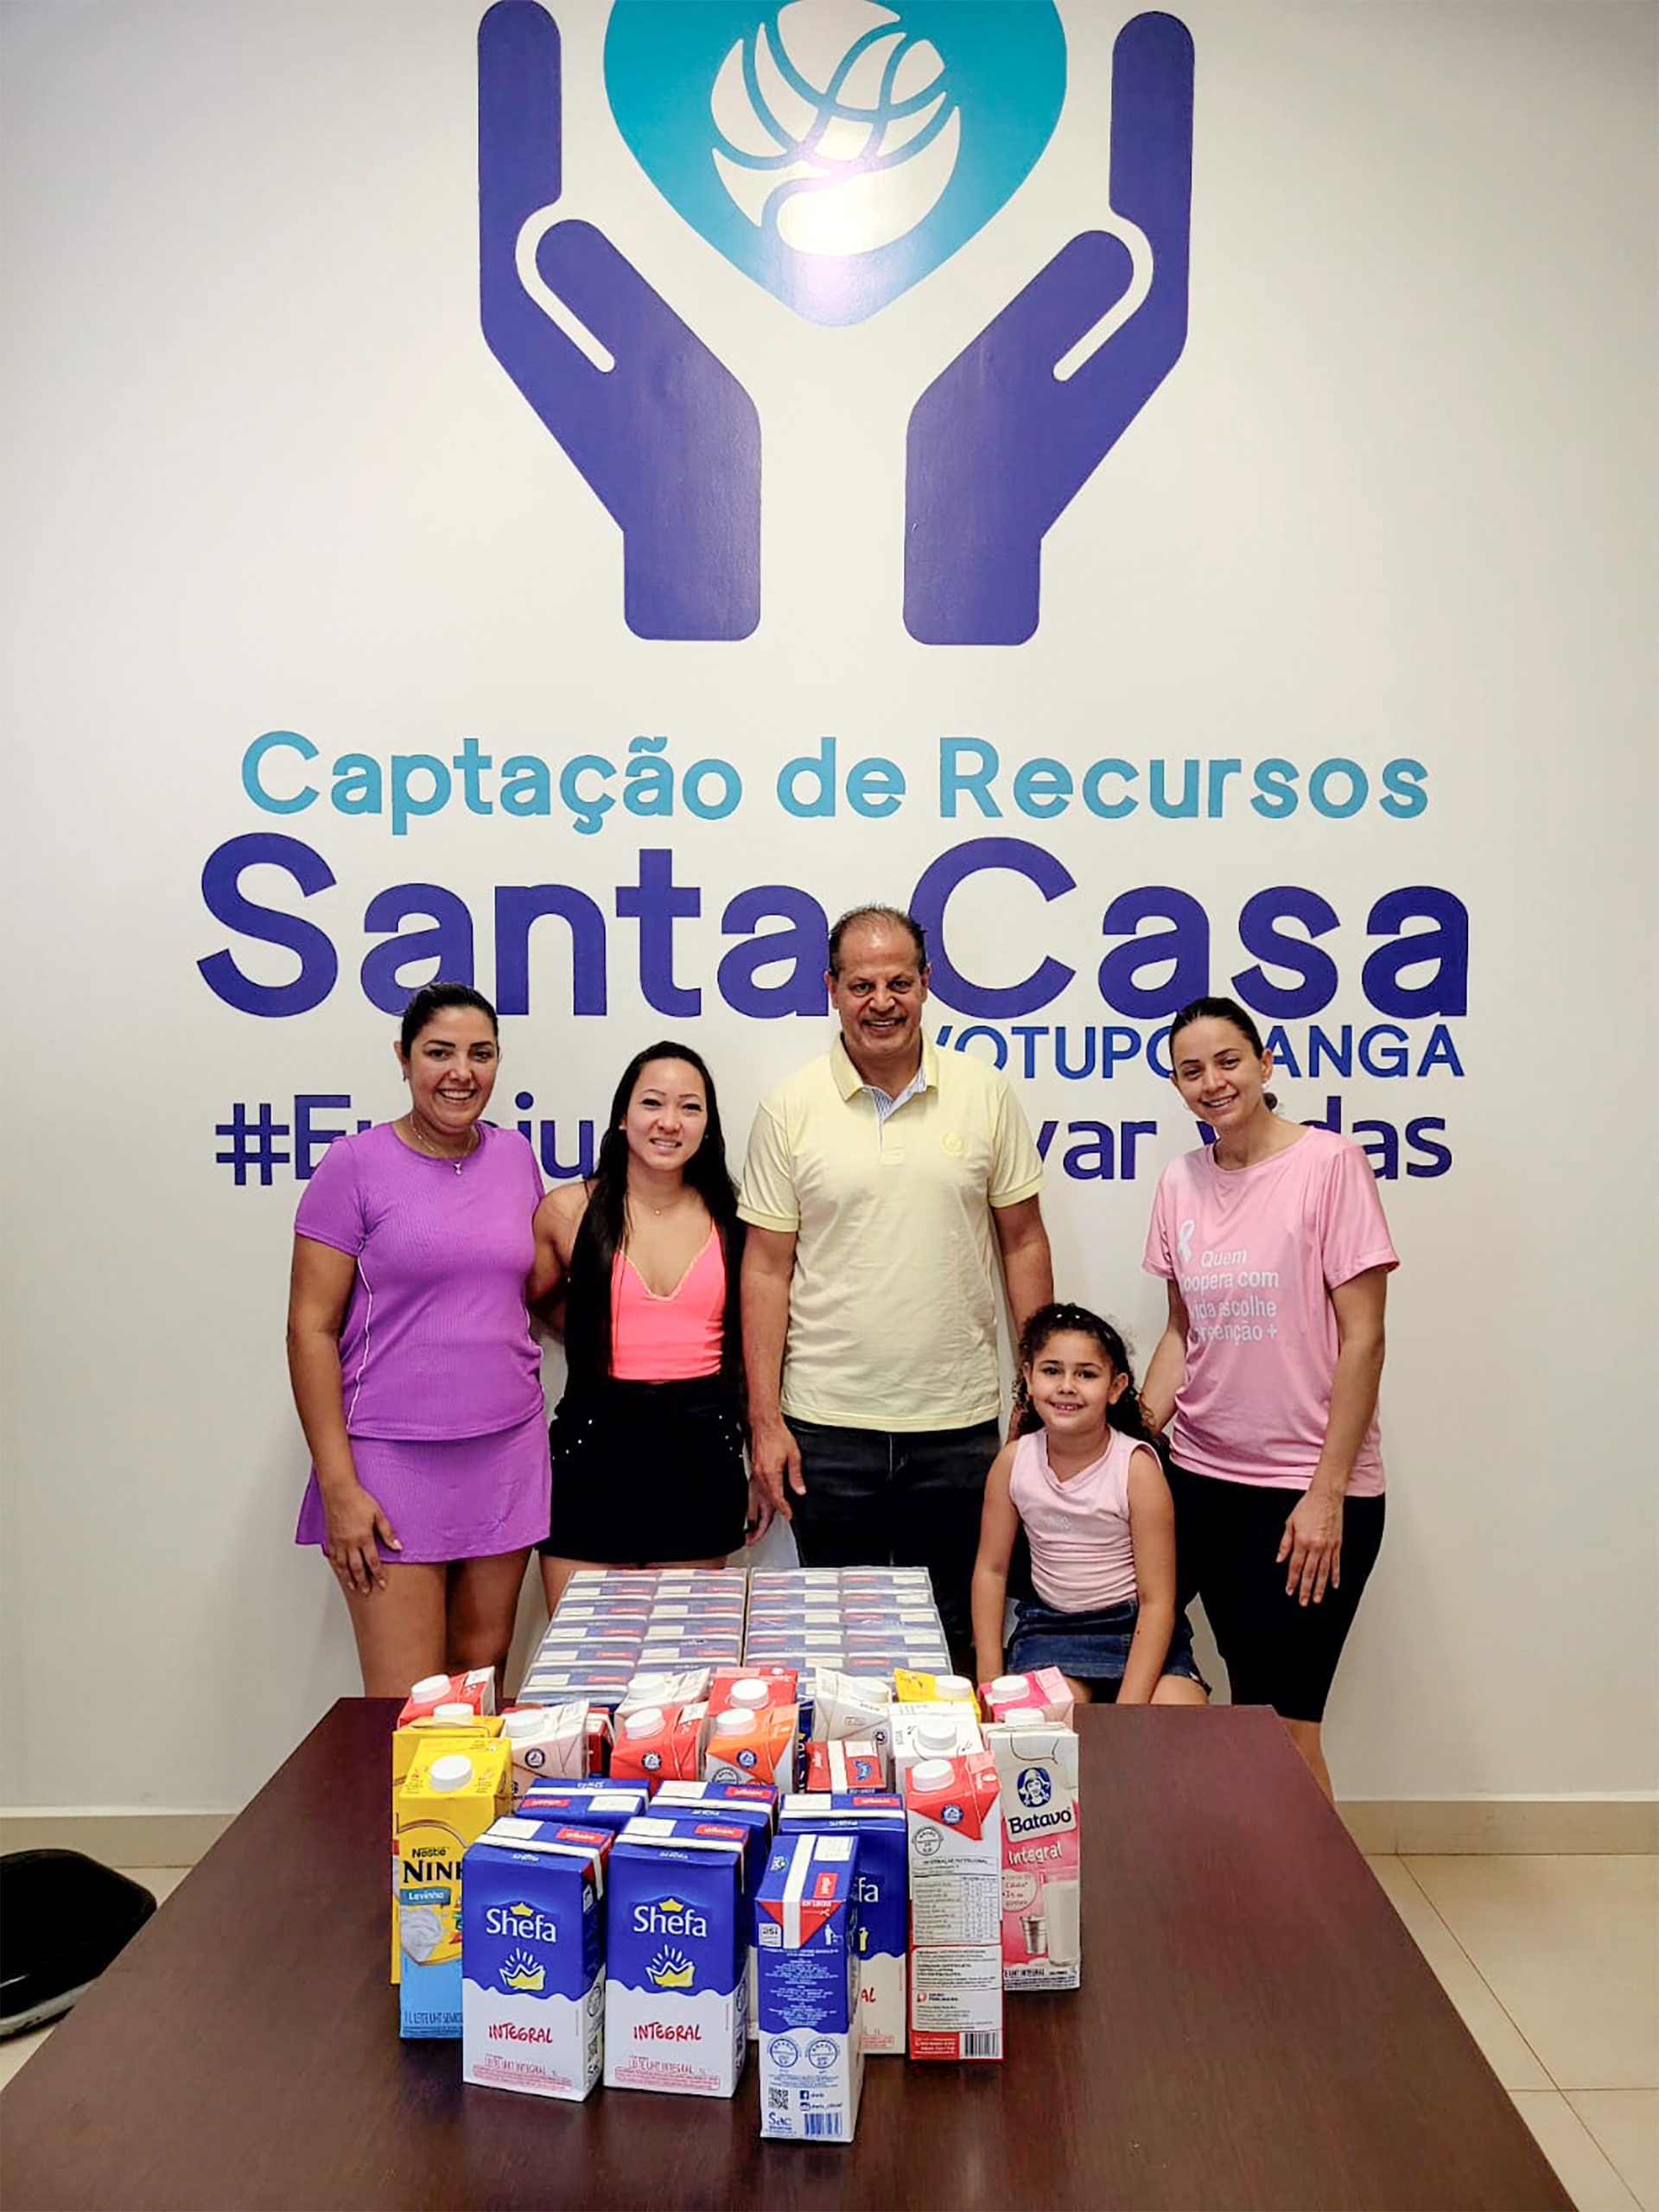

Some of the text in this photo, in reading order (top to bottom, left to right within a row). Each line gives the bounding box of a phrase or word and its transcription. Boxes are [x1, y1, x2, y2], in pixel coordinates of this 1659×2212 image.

[242, 730, 1429, 836] Captação de Recursos
[196, 832, 1469, 1020] Santa Casa
[1200, 1250, 1248, 1269] Quem
[1237, 1271, 1280, 1288] com
[1008, 1809, 1071, 1834] Batavo
[1008, 1840, 1062, 1866] Integral
[486, 1908, 556, 1942] Shefa
[633, 1905, 707, 1937] Shefa
[489, 2022, 553, 2044] INTEGRAL
[634, 2021, 702, 2042] INTEGRAL
